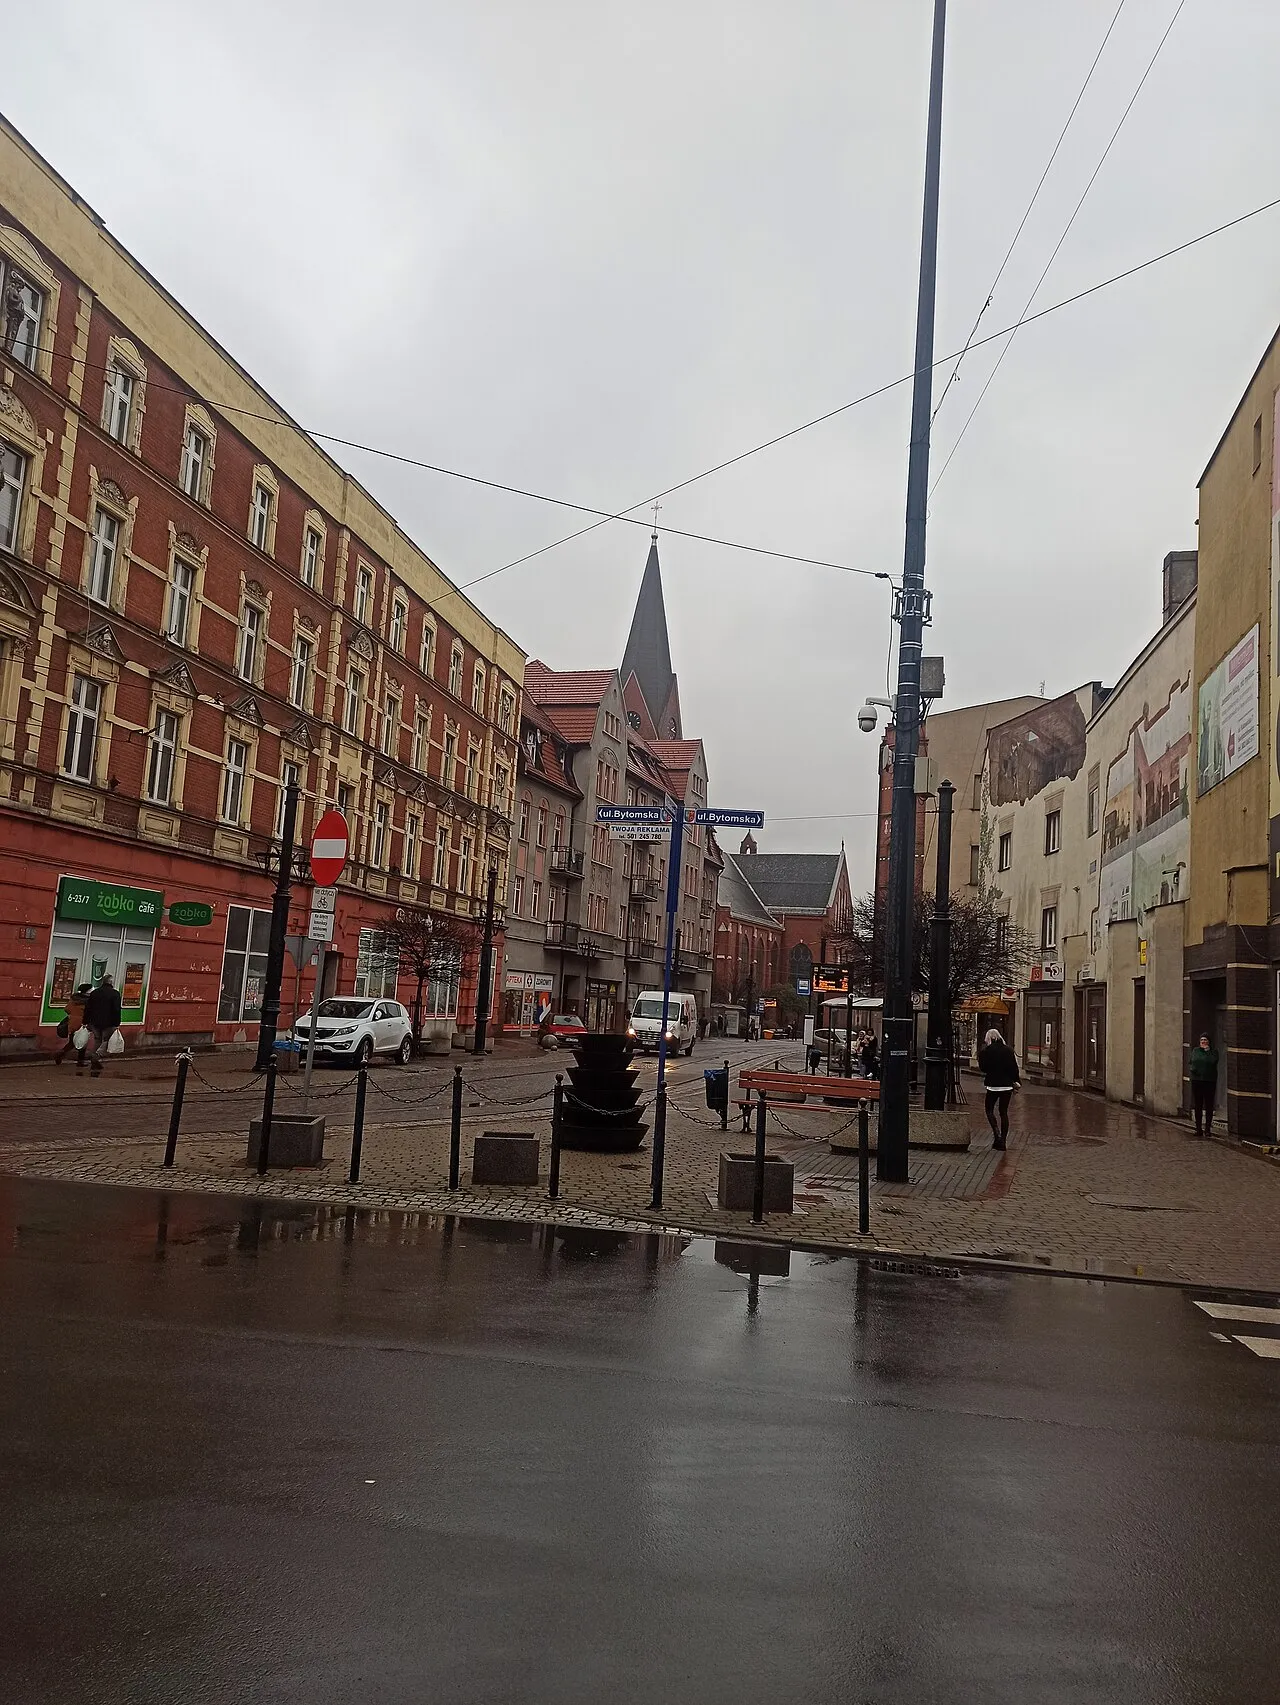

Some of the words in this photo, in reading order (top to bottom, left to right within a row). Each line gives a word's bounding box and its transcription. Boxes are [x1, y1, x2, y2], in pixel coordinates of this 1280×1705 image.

[603, 809, 659, 820] ul.Bytomska
[697, 812, 756, 824] ul.Bytomska
[67, 894, 90, 905] 6-23/7
[97, 891, 134, 911] żabka
[505, 975, 523, 984] APTEKA
